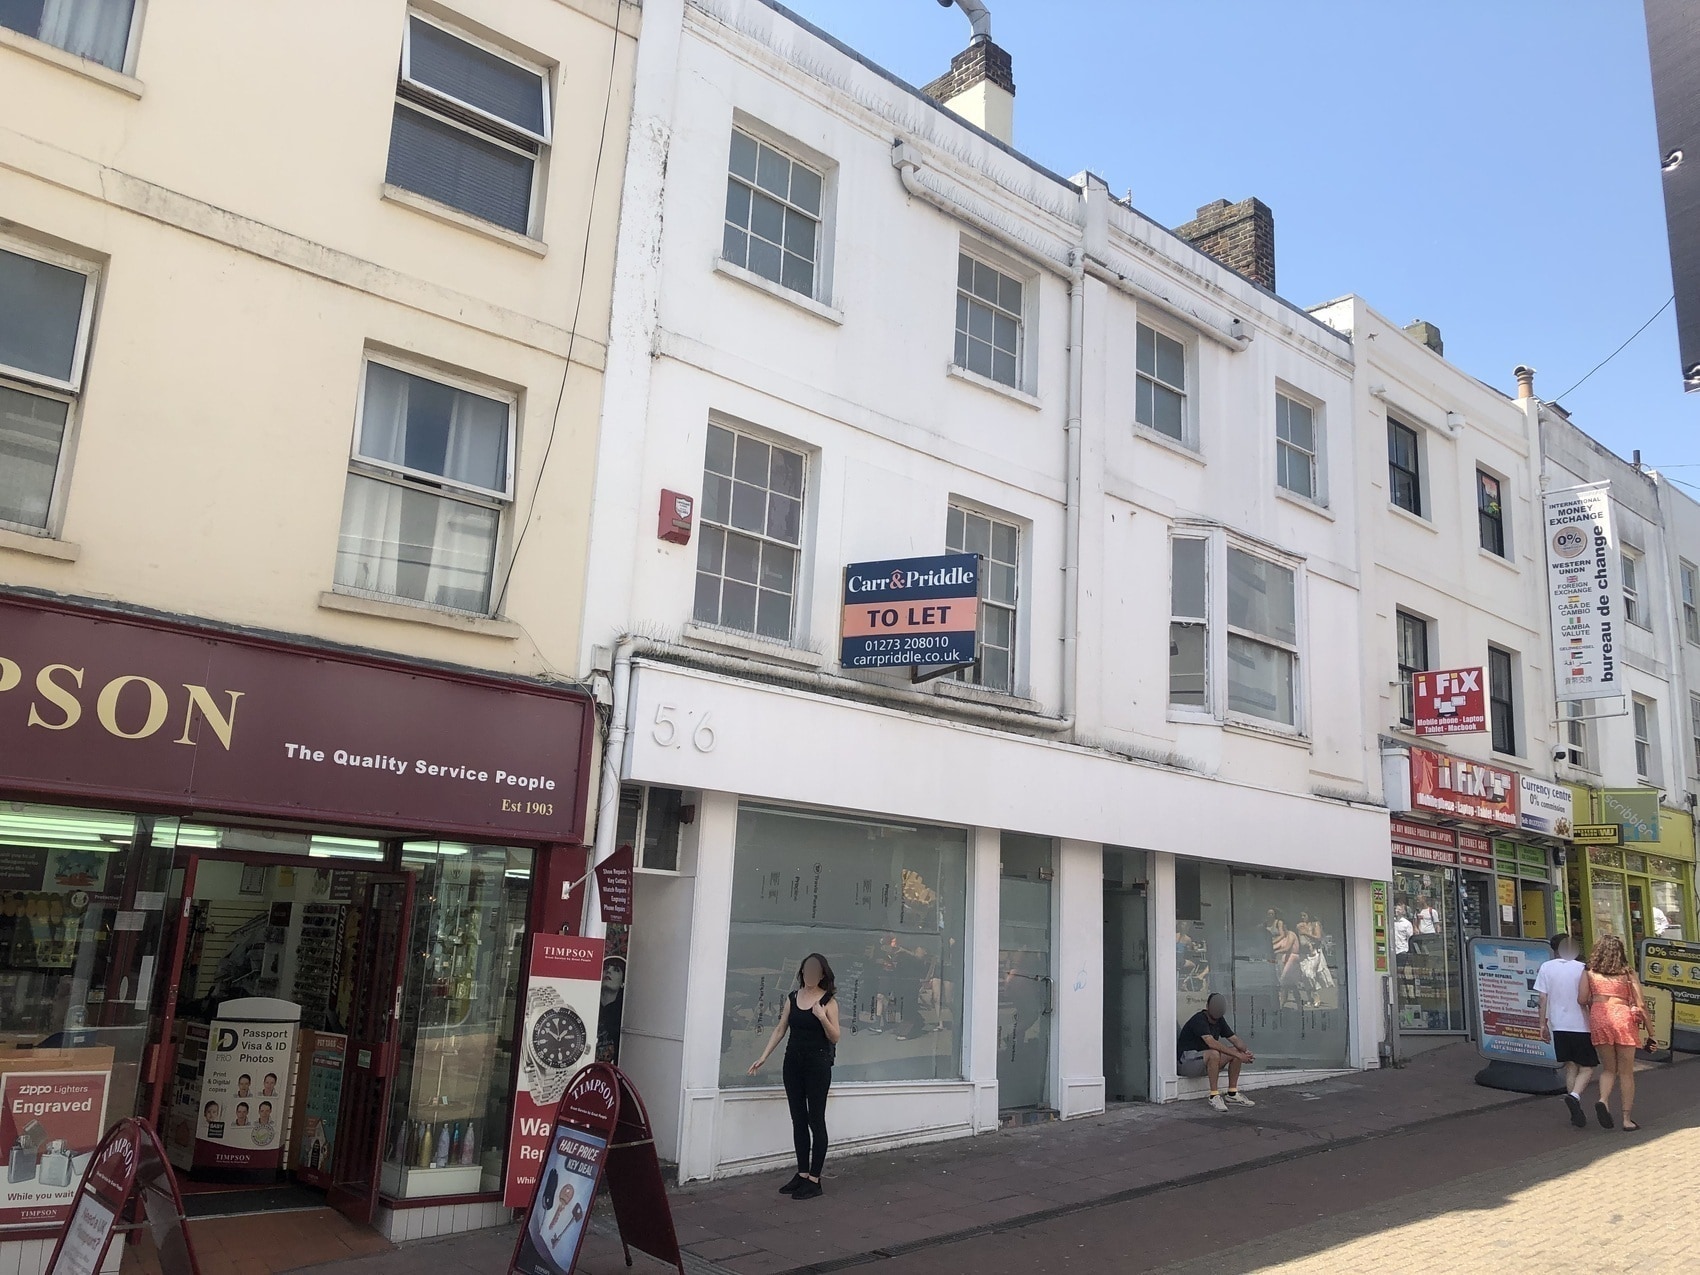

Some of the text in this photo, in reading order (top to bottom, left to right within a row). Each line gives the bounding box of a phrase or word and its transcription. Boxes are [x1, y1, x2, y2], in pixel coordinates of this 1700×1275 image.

[1549, 497, 1601, 509] INTERNATIONAL
[1558, 505, 1593, 516] MONEY
[1550, 512, 1604, 526] EXCHANGE
[1557, 533, 1581, 545] 0%
[1552, 560, 1591, 569] WESTERN
[1559, 567, 1585, 575] UNION
[848, 566, 974, 592] Carr&Priddle
[1554, 587, 1592, 596] EXCHANGE
[1557, 582, 1588, 590] FOREIGN
[1558, 603, 1578, 611] CASA
[1594, 525, 1614, 683] bureau de change
[867, 606, 951, 628] TO LET
[1561, 608, 1591, 616] CAMBIO
[1561, 623, 1591, 631] CAMBIA
[1561, 629, 1591, 637] VALUTE
[865, 636, 949, 651] 01273 208010
[853, 649, 960, 667] carrpriddle.co.uk
[285, 742, 557, 795] The Quality Service People
[1521, 777, 1572, 802] Currency centre
[501, 799, 554, 816] Est 1903
[331, 905, 347, 996] HOUSEHOLD
[544, 946, 594, 958] TIMPSON
[1648, 946, 1667, 956] 0%
[243, 1029, 288, 1040] Passport
[241, 1041, 287, 1050] Visa & ID
[239, 1054, 274, 1064] Photos
[19, 1085, 88, 1096] zippo Lighters
[571, 1079, 615, 1110] TIMPSON
[12, 1098, 92, 1116] Engraved
[520, 1117, 553, 1136] Wa
[559, 1139, 599, 1162] HALF PRICE
[215, 1153, 251, 1161] TIMPSON
[567, 1158, 592, 1176] KEY DEAL
[7, 1190, 74, 1201] While you wait
[21, 1209, 58, 1217] TIMPSON
